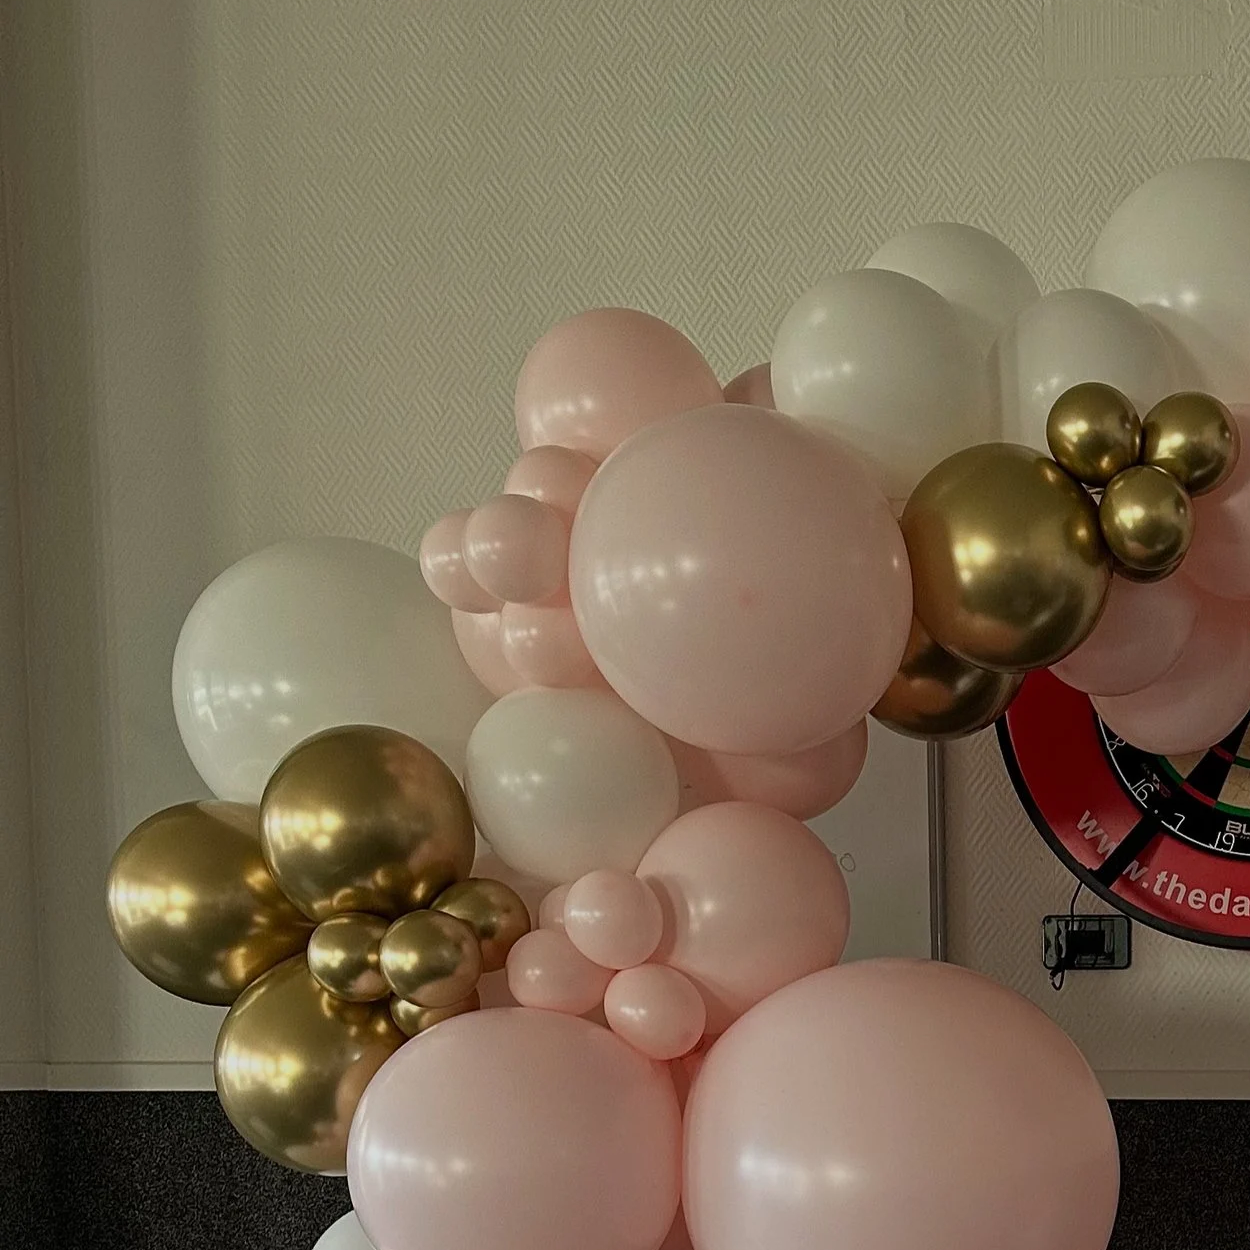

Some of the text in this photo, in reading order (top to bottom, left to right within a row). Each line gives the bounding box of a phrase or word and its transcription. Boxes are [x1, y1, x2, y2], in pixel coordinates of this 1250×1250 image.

[1129, 778, 1154, 801] 16
[1173, 812, 1186, 832] 7
[1209, 831, 1236, 852] 19
